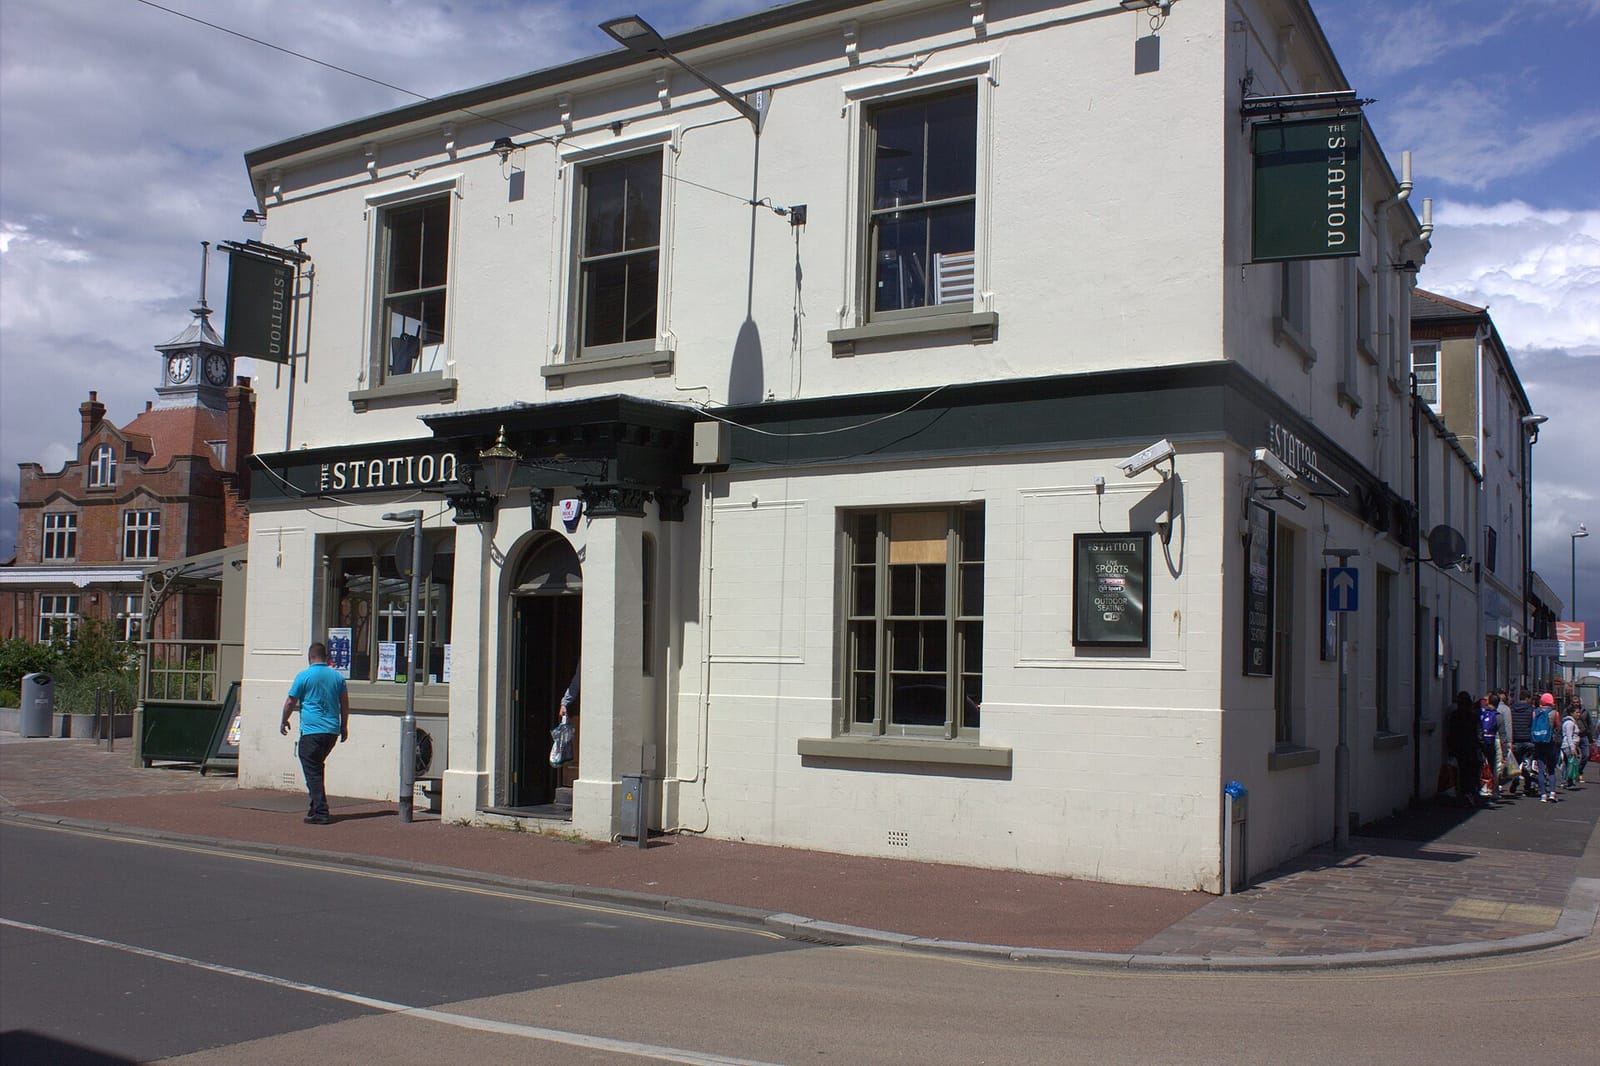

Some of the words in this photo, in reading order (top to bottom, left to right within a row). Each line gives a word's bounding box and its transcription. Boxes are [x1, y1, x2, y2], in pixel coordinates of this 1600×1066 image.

[1328, 124, 1346, 133] THE
[1327, 136, 1347, 247] STATION
[269, 277, 286, 354] STATION
[1275, 423, 1318, 483] STATION
[320, 463, 330, 492] THE
[332, 452, 459, 490] STATION
[1092, 542, 1136, 552] STATION
[1095, 564, 1129, 574] SPORTS
[1094, 597, 1128, 605] OUTDOOR
[1097, 604, 1125, 612] SEATING
